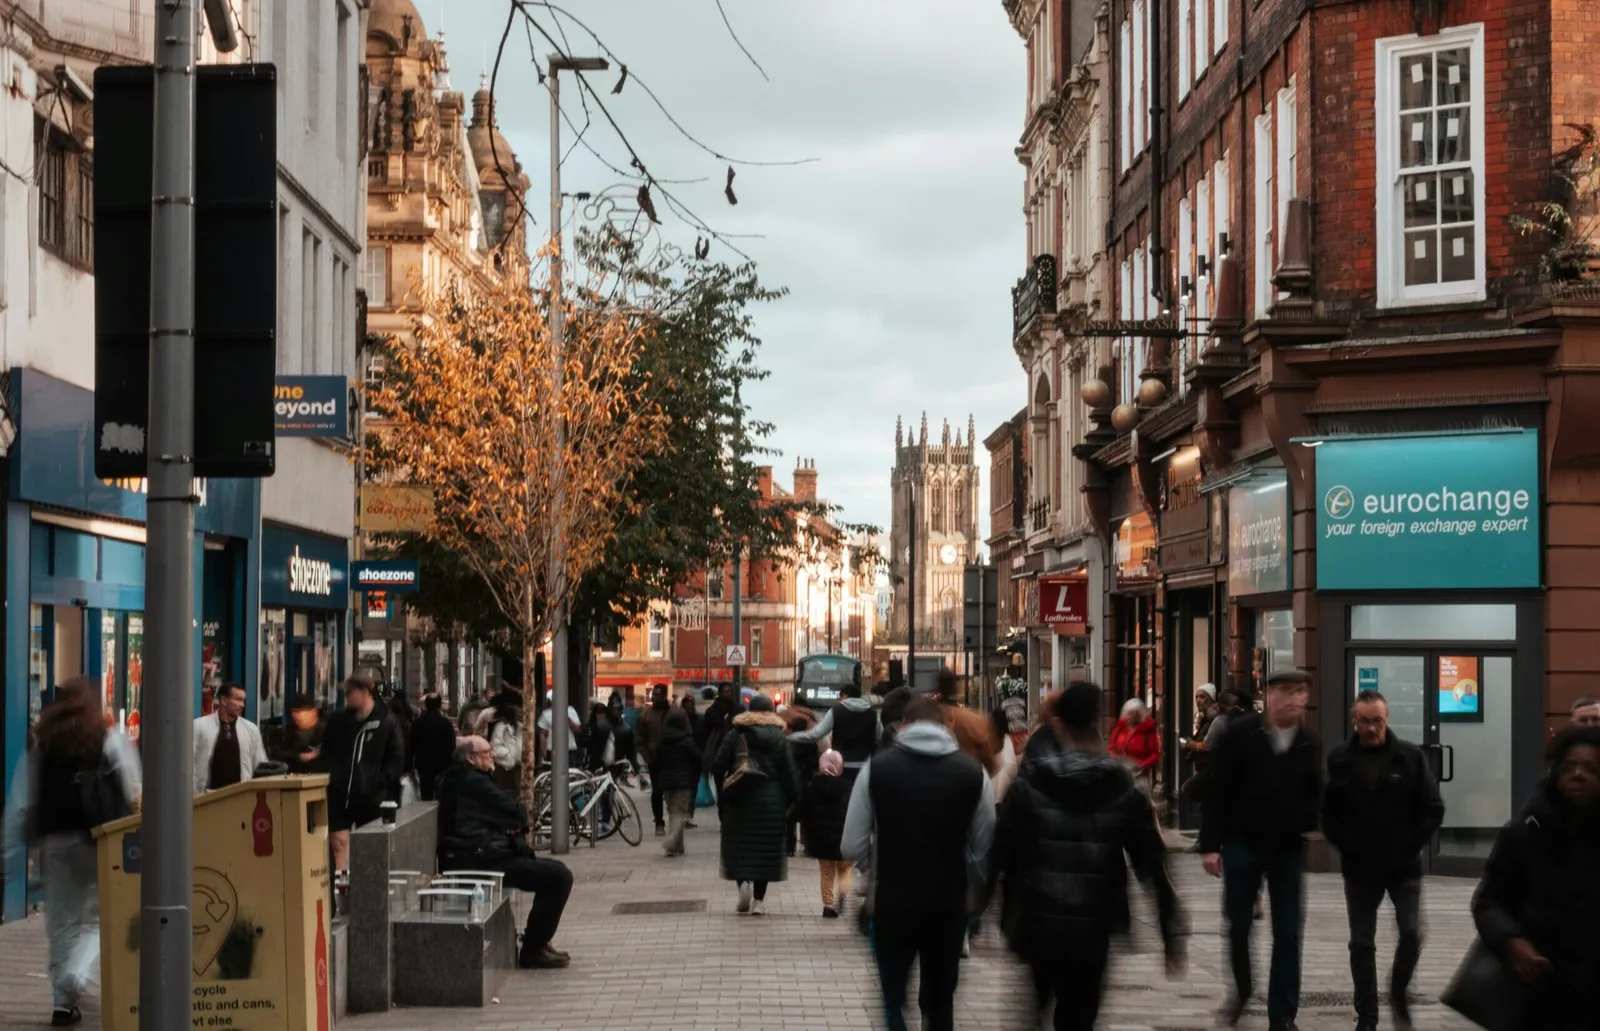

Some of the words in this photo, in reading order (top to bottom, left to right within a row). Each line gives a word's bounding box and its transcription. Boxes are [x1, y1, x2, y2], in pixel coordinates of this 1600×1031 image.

[1083, 320, 1139, 331] INSTANT
[1143, 320, 1179, 331] CASH
[275, 398, 336, 419] eyond
[1363, 487, 1530, 517] eurochange
[1241, 513, 1281, 550] eurochange
[1325, 521, 1356, 539] your
[1360, 519, 1405, 538] foreign
[1410, 518, 1477, 536] exchange
[1482, 516, 1529, 534] expert
[291, 544, 331, 596] shoezone
[359, 568, 415, 581] shoezone
[1055, 585, 1072, 612] L
[1044, 614, 1083, 622] Ladbrokes
[193, 984, 227, 998] cycle
[216, 999, 239, 1010] and
[243, 1000, 276, 1010] cans,
[208, 1015, 233, 1026] else
